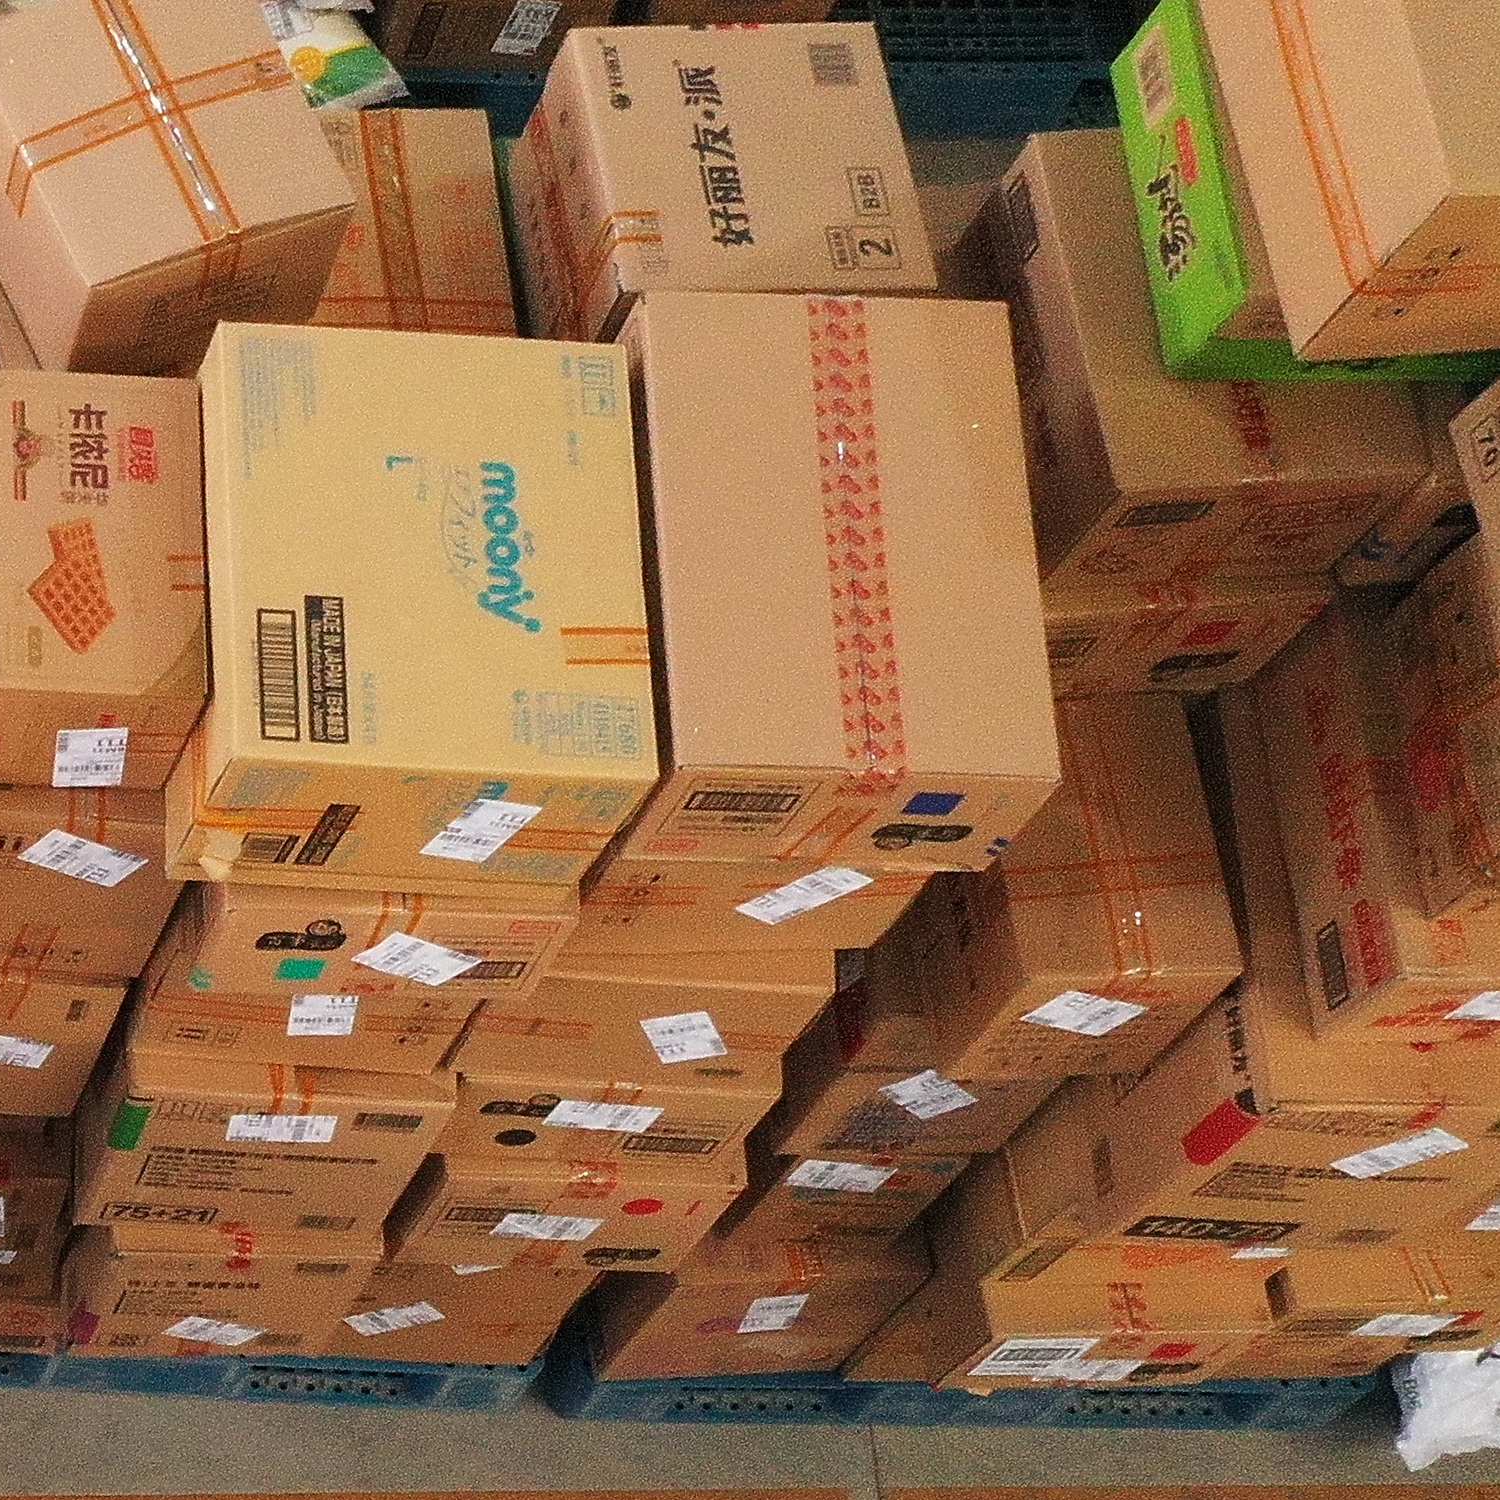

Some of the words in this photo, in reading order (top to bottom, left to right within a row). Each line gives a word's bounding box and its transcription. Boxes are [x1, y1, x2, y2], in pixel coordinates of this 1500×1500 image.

[681, 60, 755, 250] 好丽友·派
[860, 172, 880, 210] B2B
[860, 233, 893, 258] 2
[386, 453, 413, 471] L
[477, 460, 543, 633] moony
[321, 599, 341, 632] MADE
[323, 635, 341, 646] IN
[324, 649, 343, 686] JAPAN
